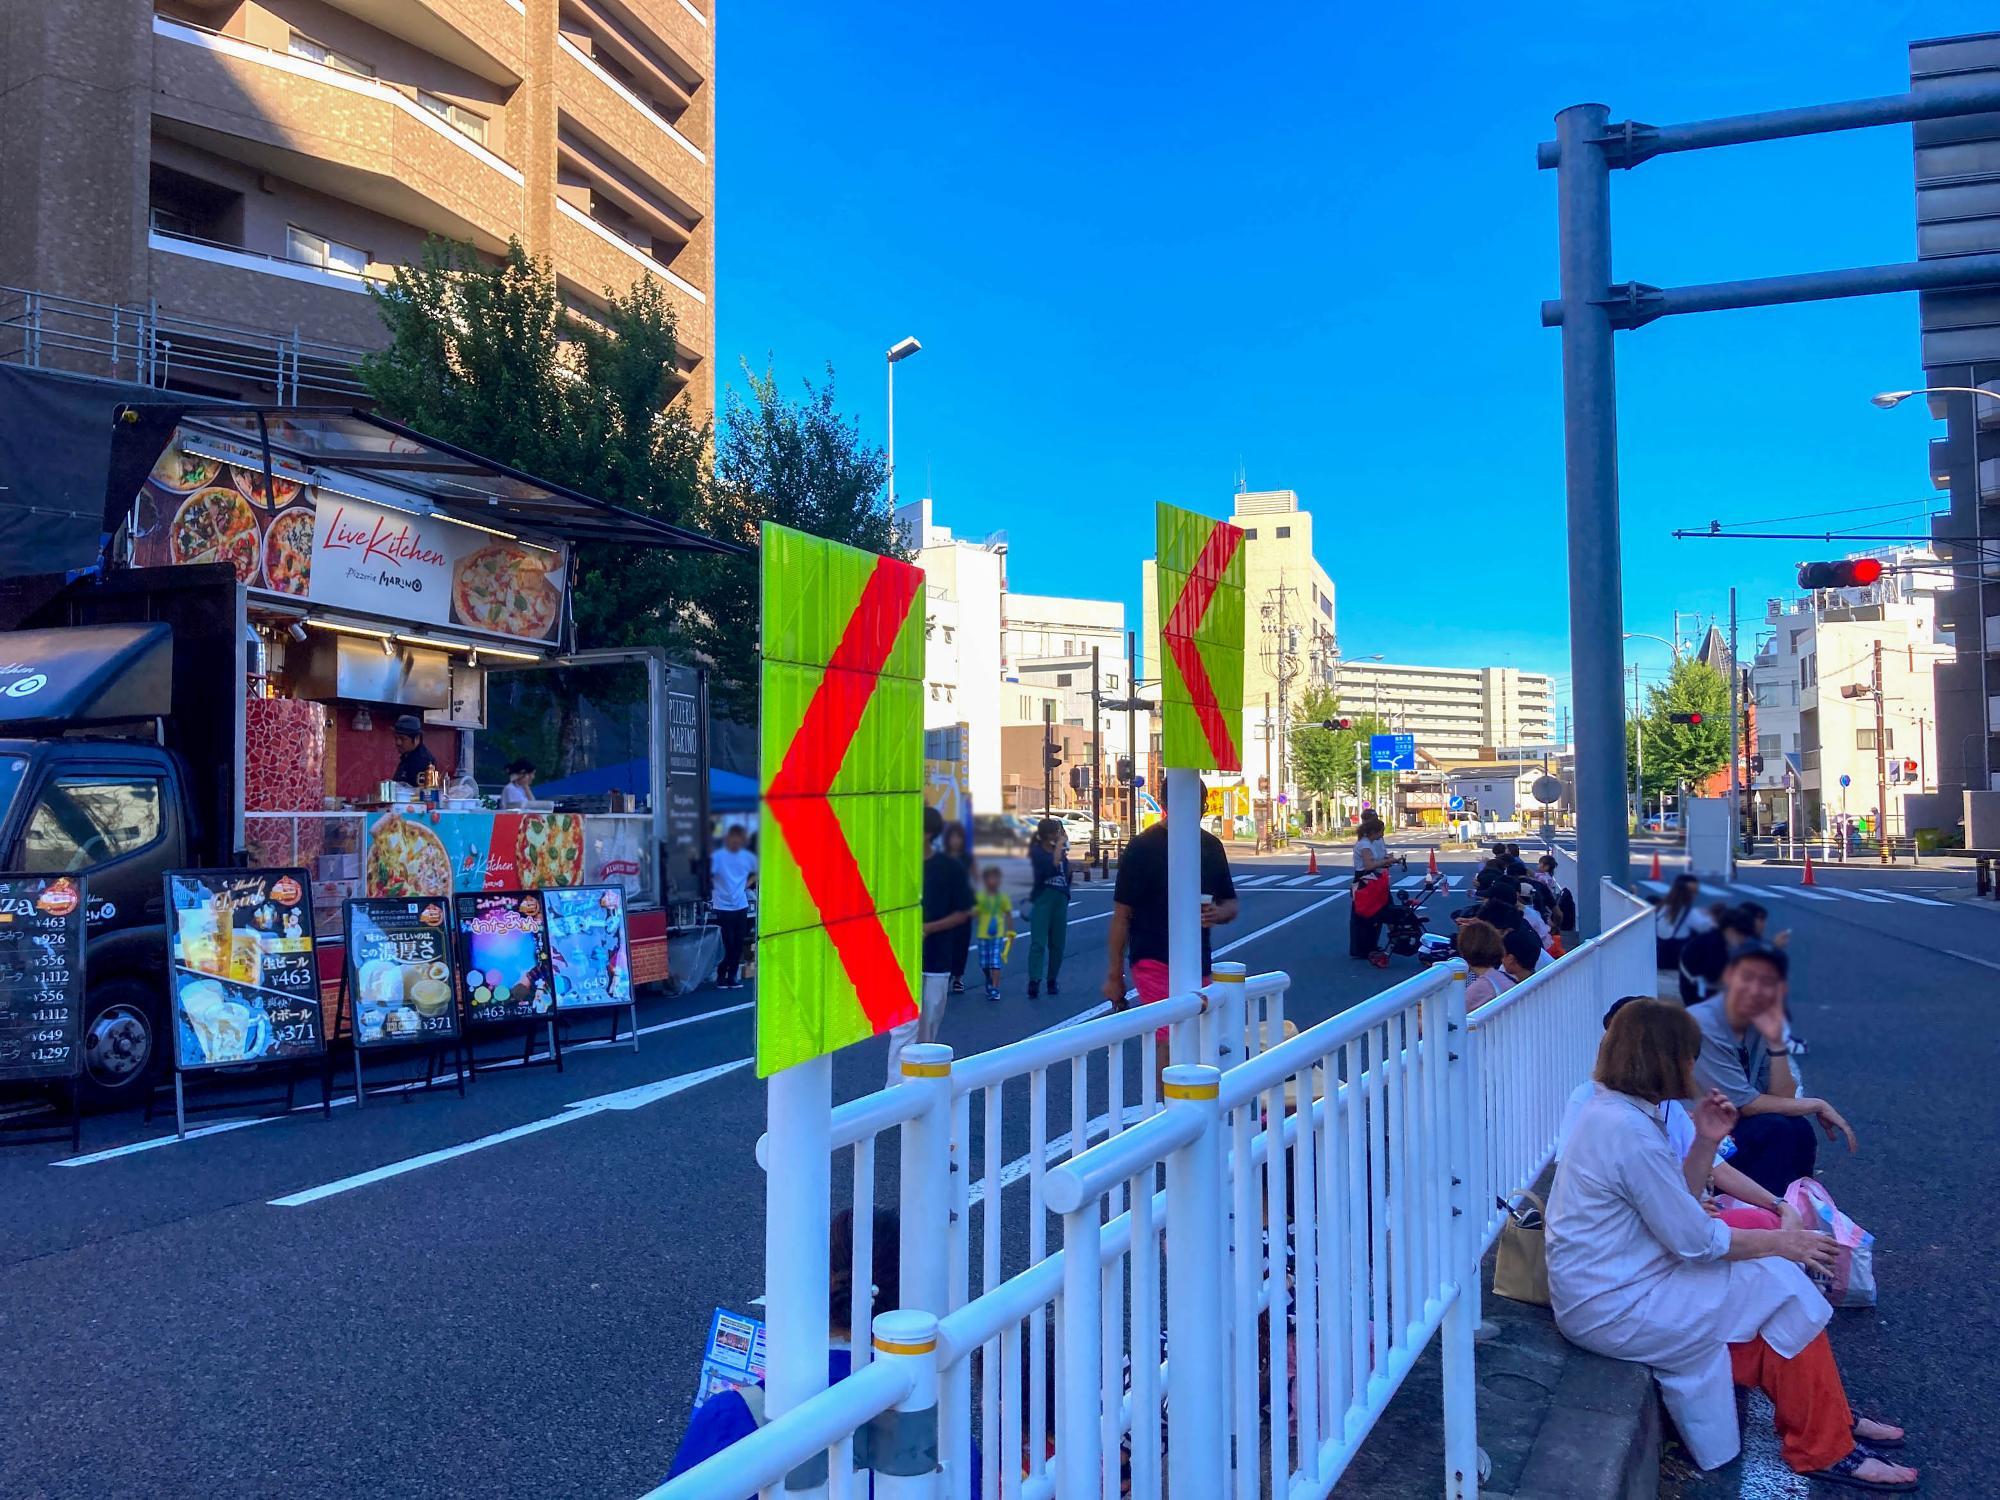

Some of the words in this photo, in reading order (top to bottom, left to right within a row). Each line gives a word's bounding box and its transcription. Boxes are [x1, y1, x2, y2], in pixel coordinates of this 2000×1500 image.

[669, 699, 696, 726] PIZZERIA
[669, 727, 697, 754] MARINO
[36, 917, 66, 928] ¥463
[472, 911, 539, 934] わたあめ
[361, 940, 436, 961] この濃厚さ
[34, 954, 66, 966] ¥556
[263, 956, 310, 971] 生ビール
[272, 969, 311, 986] ¥463
[33, 990, 64, 1002] ¥556
[423, 1017, 452, 1030] ¥371
[32, 1030, 63, 1042] ¥649
[276, 1024, 316, 1041] ¥371
